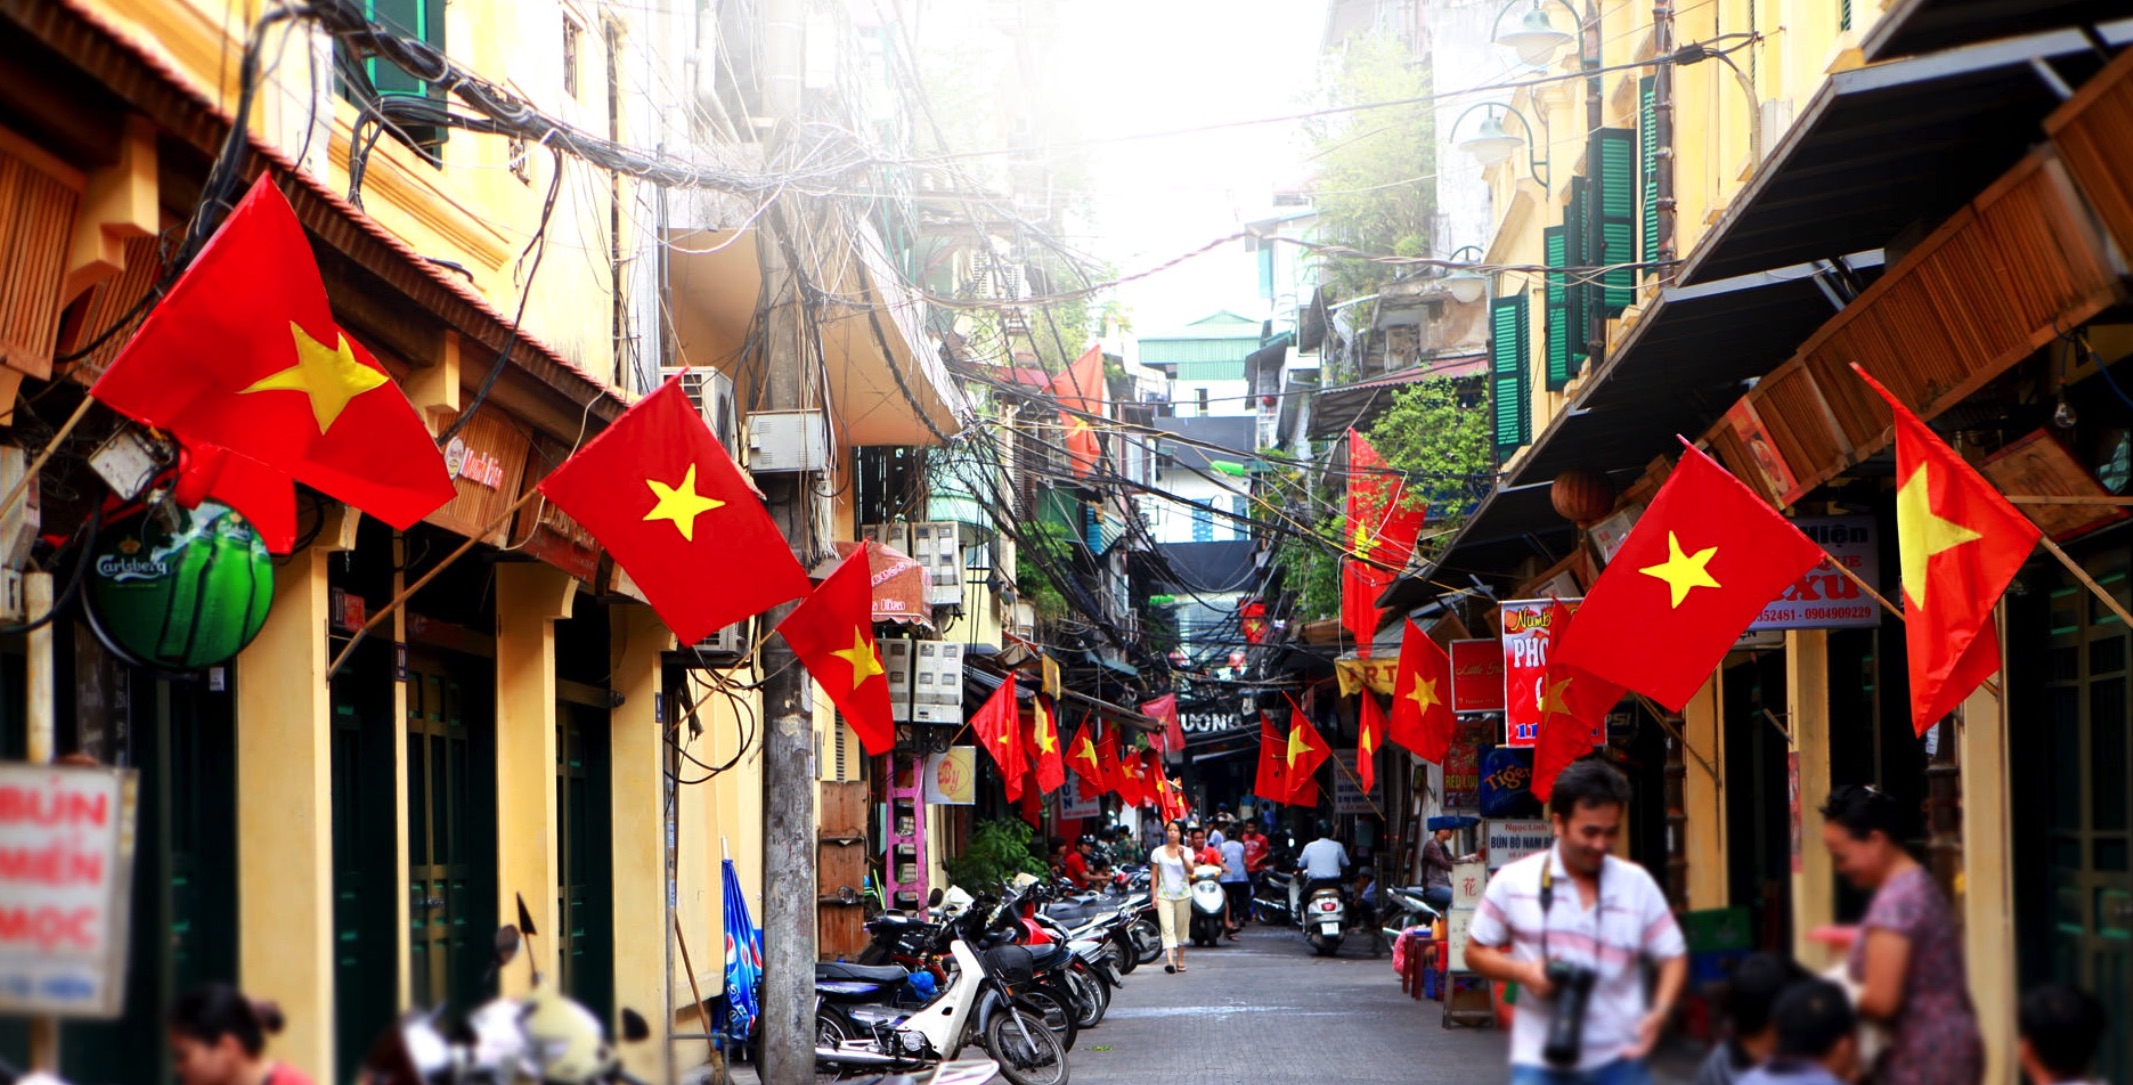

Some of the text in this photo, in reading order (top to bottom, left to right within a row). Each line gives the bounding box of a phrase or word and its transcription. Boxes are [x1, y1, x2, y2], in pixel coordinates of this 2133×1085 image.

[96, 554, 168, 577] Carlsberg
[1523, 836, 1542, 849] NAM
[1463, 876, 1477, 897] 花
